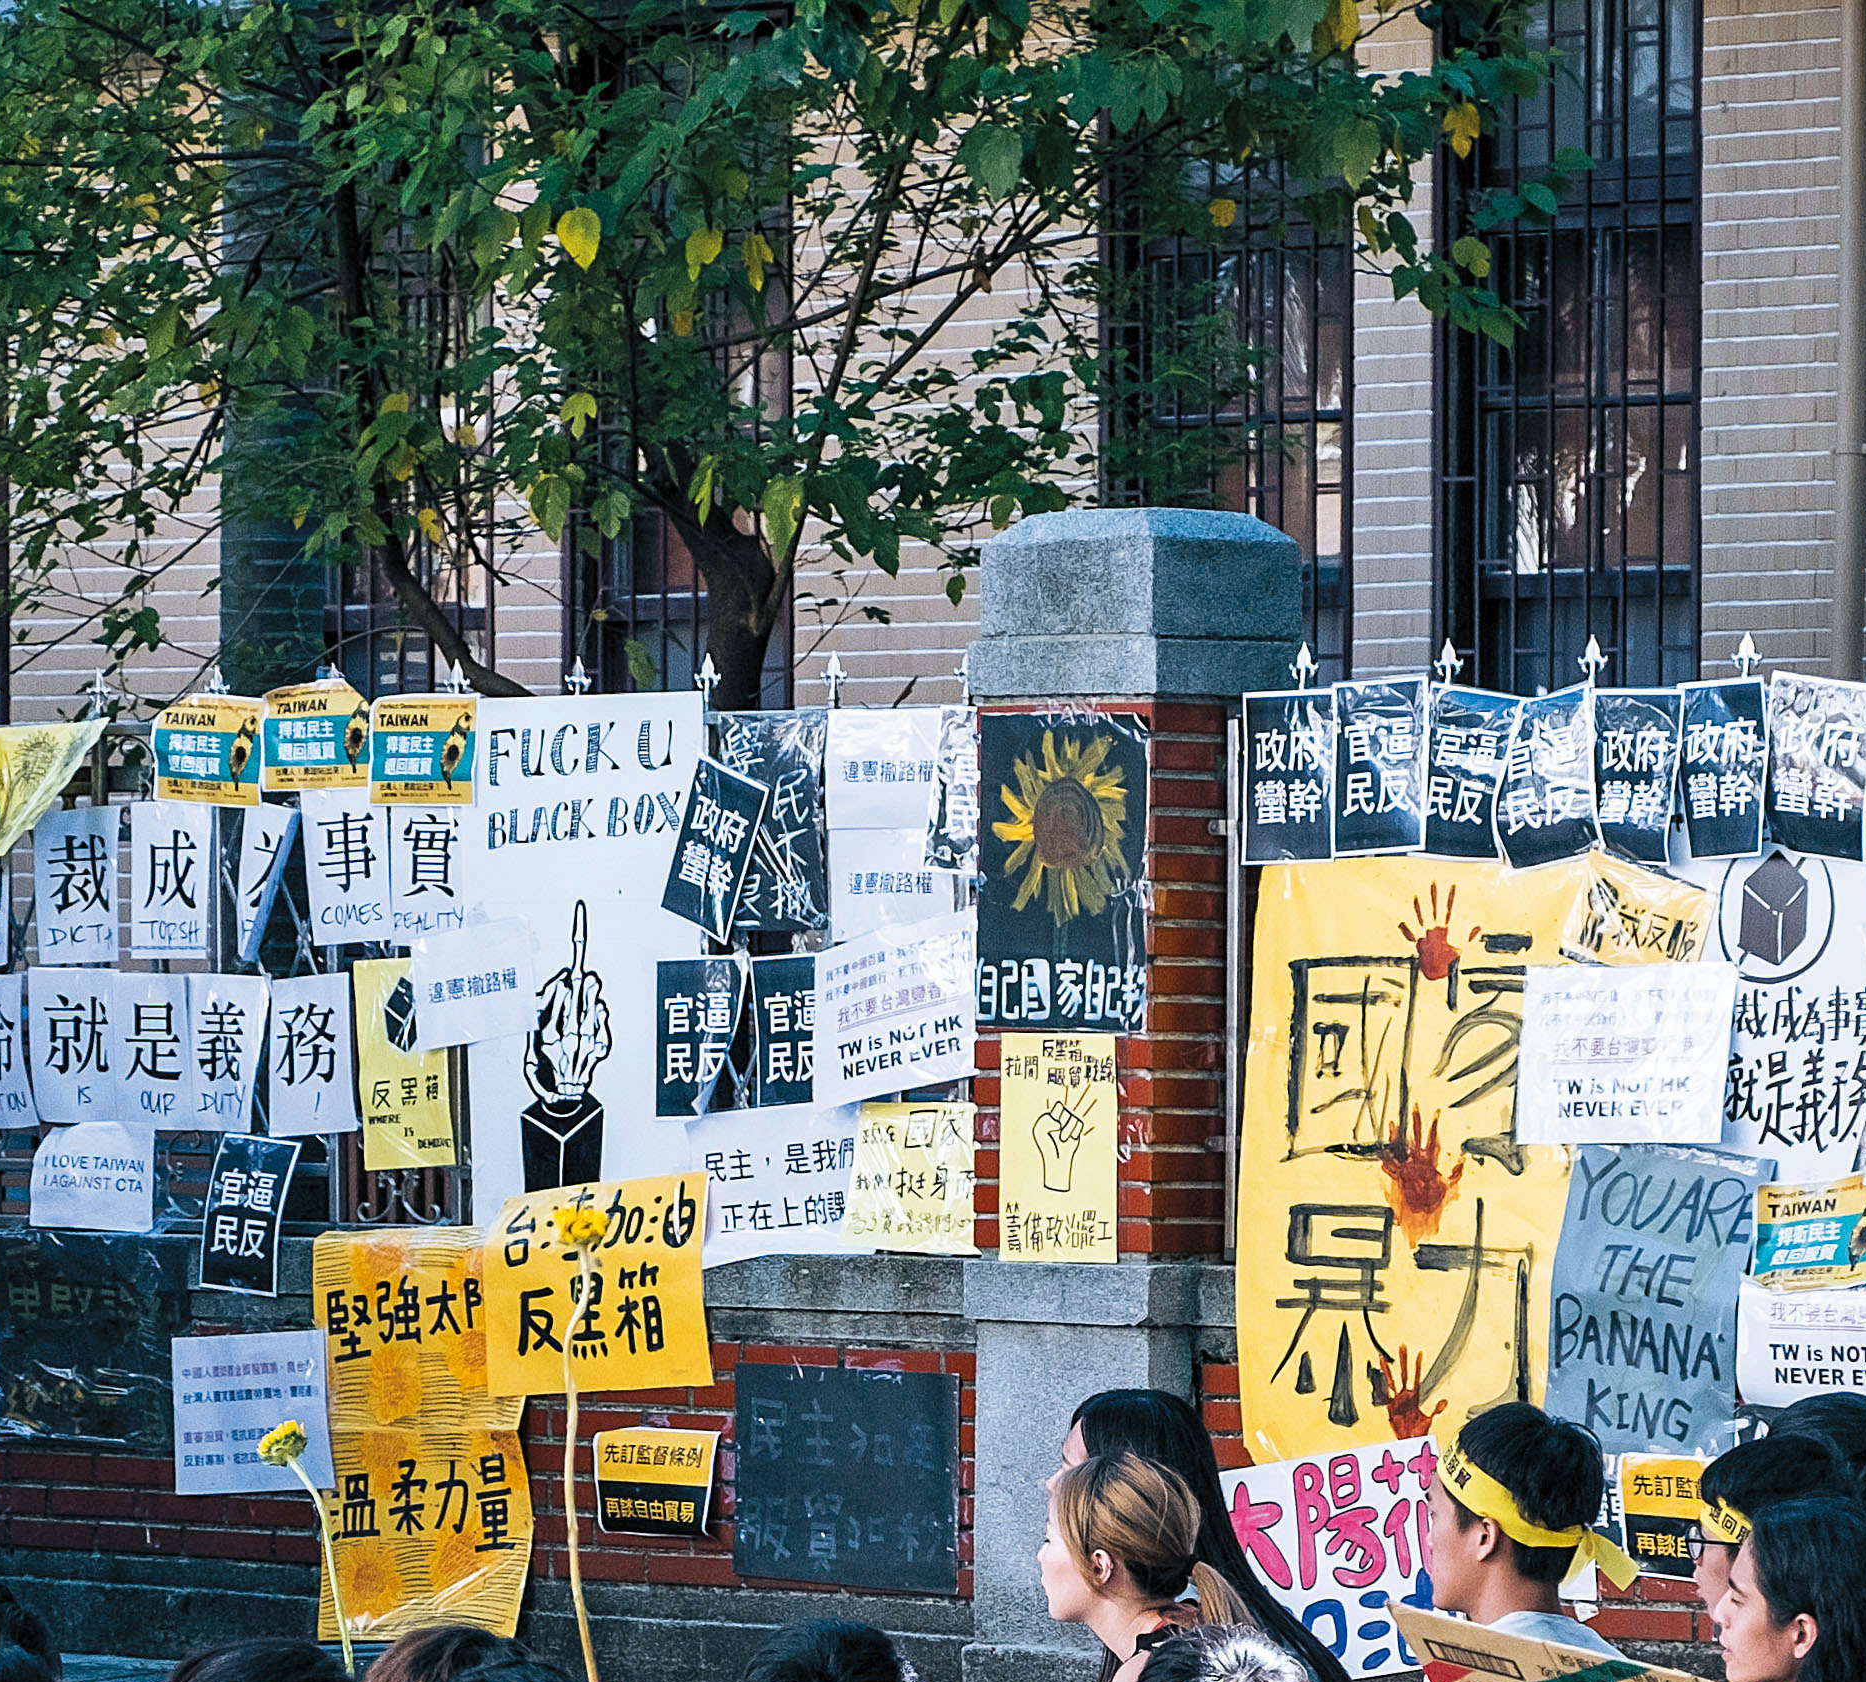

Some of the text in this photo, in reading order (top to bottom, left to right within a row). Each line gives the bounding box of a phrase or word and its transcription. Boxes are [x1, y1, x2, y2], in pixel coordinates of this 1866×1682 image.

[165, 712, 216, 727] TAIWAN
[276, 699, 328, 714] TAIWAN
[379, 713, 429, 728] TAIWAN
[488, 718, 673, 787] FUCK U
[1255, 724, 1323, 773] 政府
[1344, 716, 1414, 770] 官逼
[1601, 725, 1669, 773] 政府
[1686, 715, 1758, 764] 政府
[1343, 771, 1413, 819] 民反
[487, 789, 681, 850] BLACK BOX
[690, 795, 750, 854] 政府
[664, 991, 732, 1035] 官逼
[663, 1042, 728, 1085] 民反
[843, 1048, 903, 1080] NEVER
[50, 1176, 111, 1192] AGAINST
[52, 1155, 89, 1170] LOVE
[94, 1156, 145, 1174] TAIWAN
[219, 1169, 279, 1213] 官逼
[1768, 1198, 1837, 1219] TAIWAN
[210, 1216, 267, 1260] 民反
[1598, 1244, 1697, 1308] THE
[518, 1262, 666, 1359] 反黑箱
[1769, 1343, 1801, 1361] TW
[1807, 1343, 1824, 1362] is
[1774, 1367, 1845, 1388] NEVER
[1585, 1378, 1694, 1443] KING
[603, 1441, 703, 1470] 先訂監督條例
[330, 1451, 516, 1555] 溫柔力量
[604, 1495, 697, 1526] 再談自由貿易
